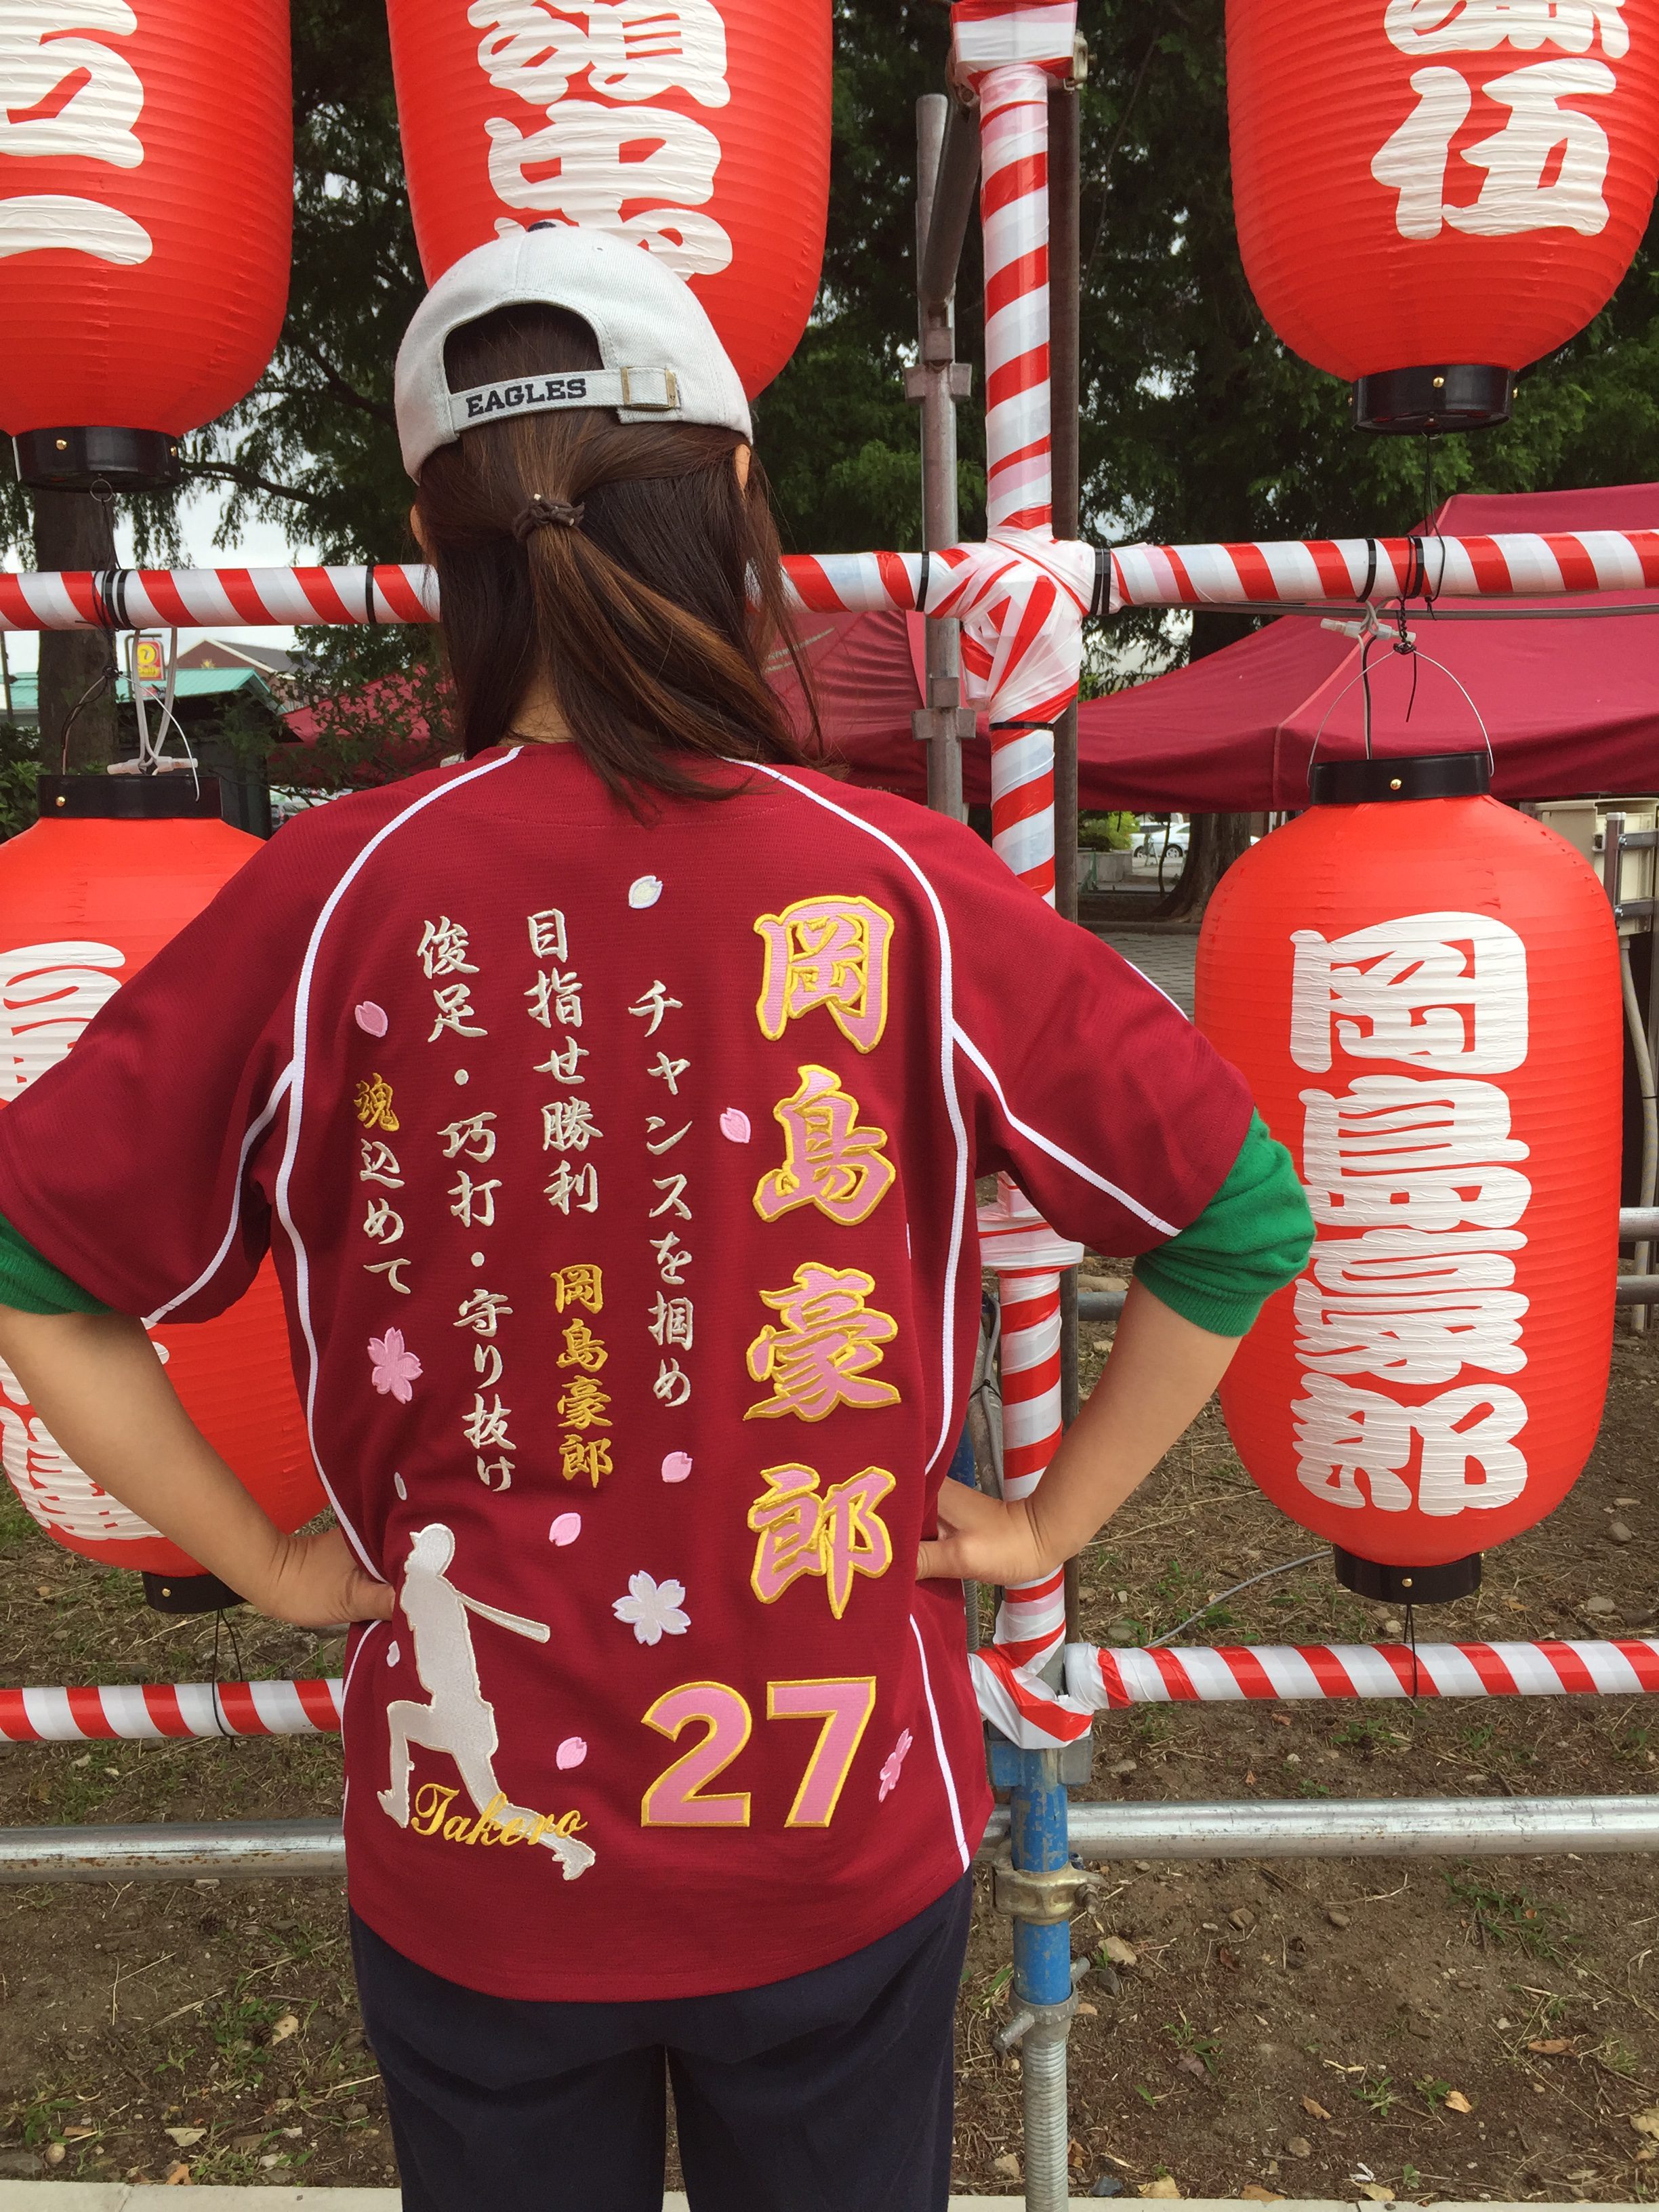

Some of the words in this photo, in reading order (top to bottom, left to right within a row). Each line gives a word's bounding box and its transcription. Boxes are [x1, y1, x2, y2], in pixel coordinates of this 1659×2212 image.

[466, 377, 587, 417] EAGLES
[523, 907, 605, 1216] 目指せ勝利
[354, 1072, 412, 1295] 魂込めて
[743, 894, 902, 1620] 岡島豪郎
[550, 1263, 615, 1488] 岡島豪郎
[411, 1782, 589, 1847] Takero
[640, 1675, 877, 1828] 27
